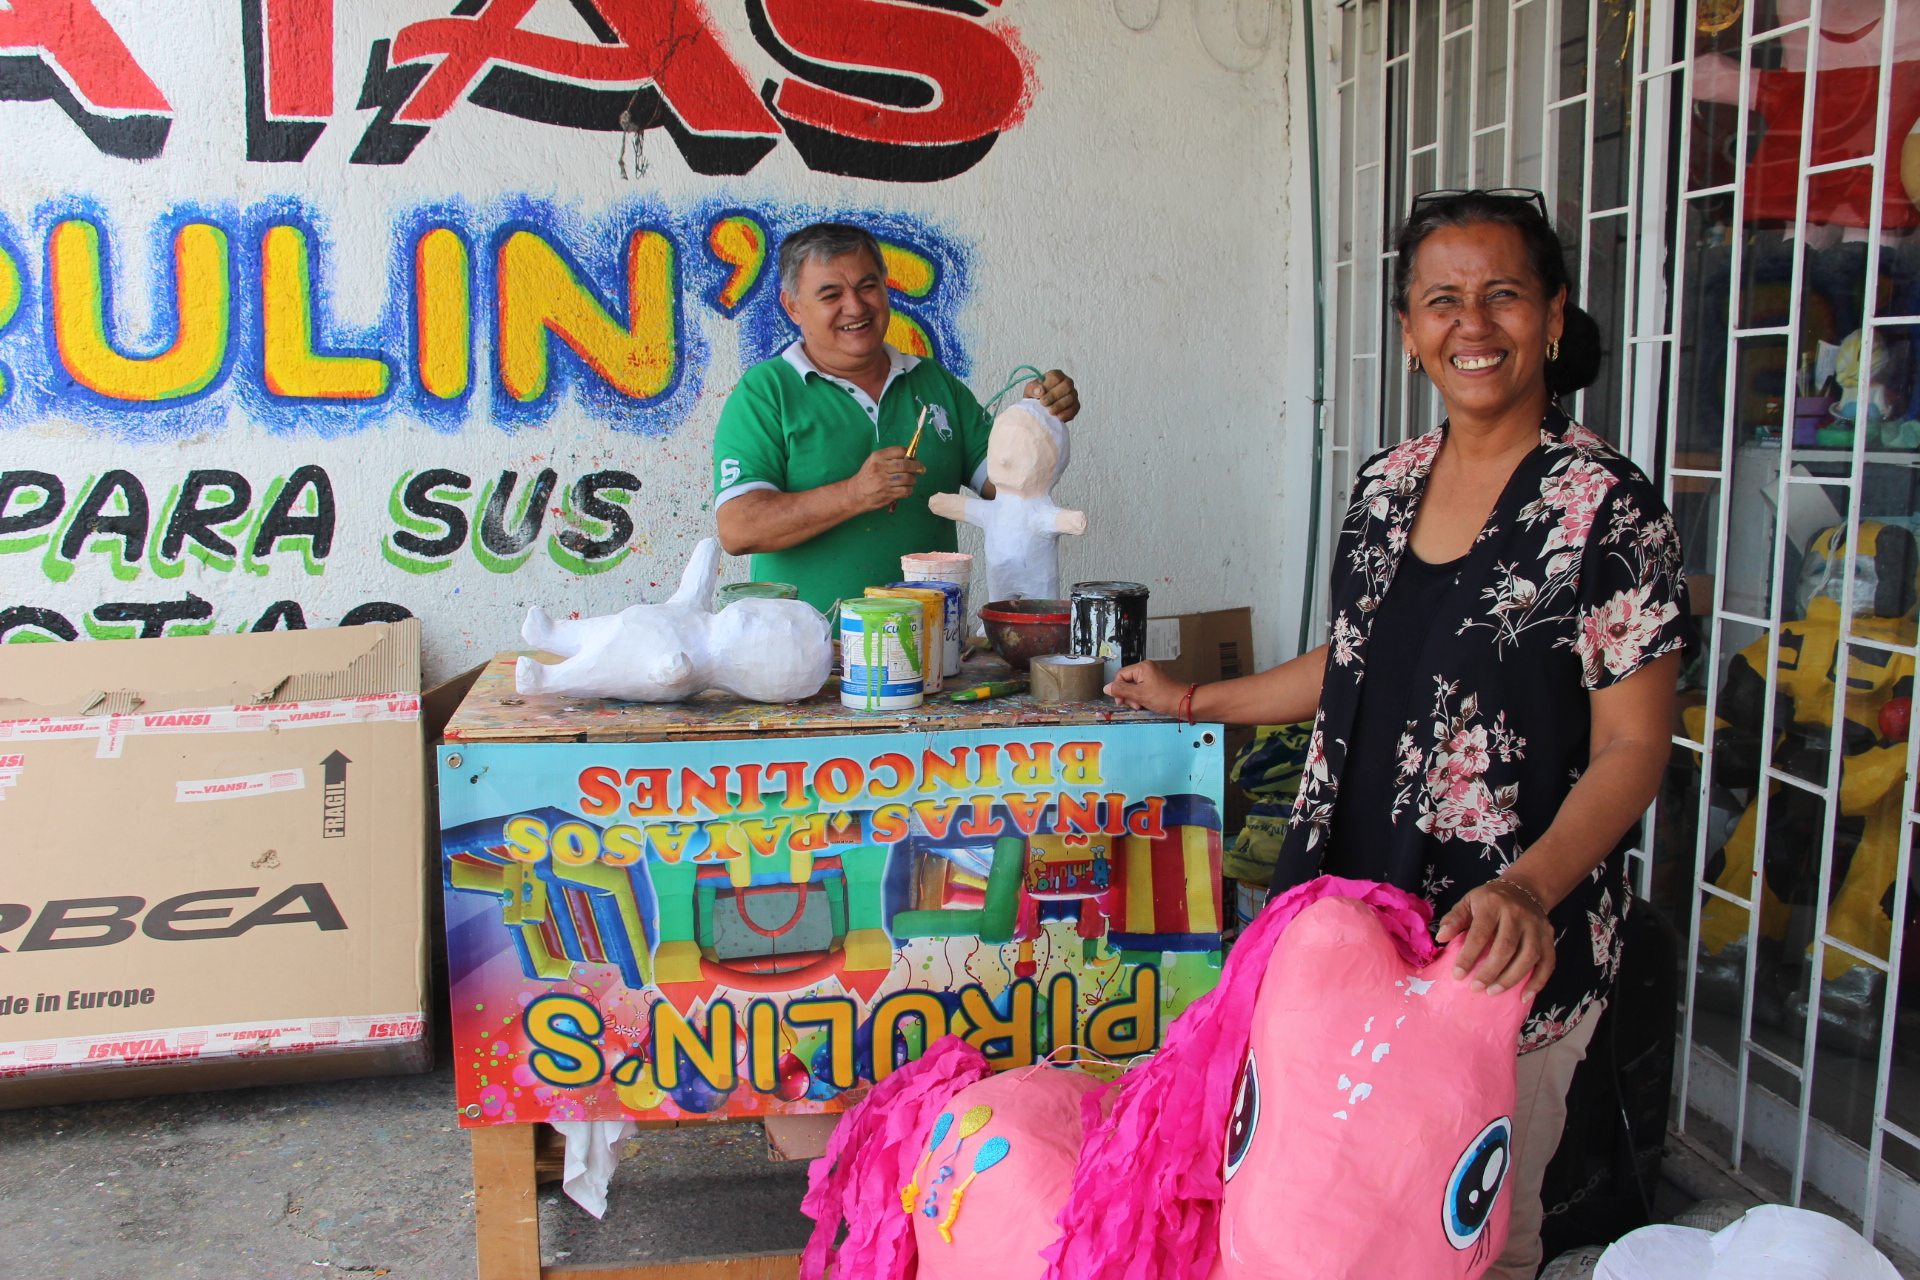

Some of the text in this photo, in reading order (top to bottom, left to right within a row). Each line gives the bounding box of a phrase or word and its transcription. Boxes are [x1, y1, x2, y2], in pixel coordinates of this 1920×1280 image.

[383, 467, 641, 570] SUS
[20, 722, 100, 733] www.VIANSI.com
[144, 714, 212, 727] VIANSI
[271, 710, 346, 723] www.VIANSI.com
[184, 781, 264, 794] www.VIANSI.com
[578, 741, 1103, 817] BRINCOLINES
[324, 780, 345, 838] FRAGIL
[508, 792, 1167, 866] PIÑATAS PAYASOS
[35, 993, 61, 1013] in
[66, 987, 156, 1010] Europe
[523, 966, 1160, 1094] PIRULIN'S
